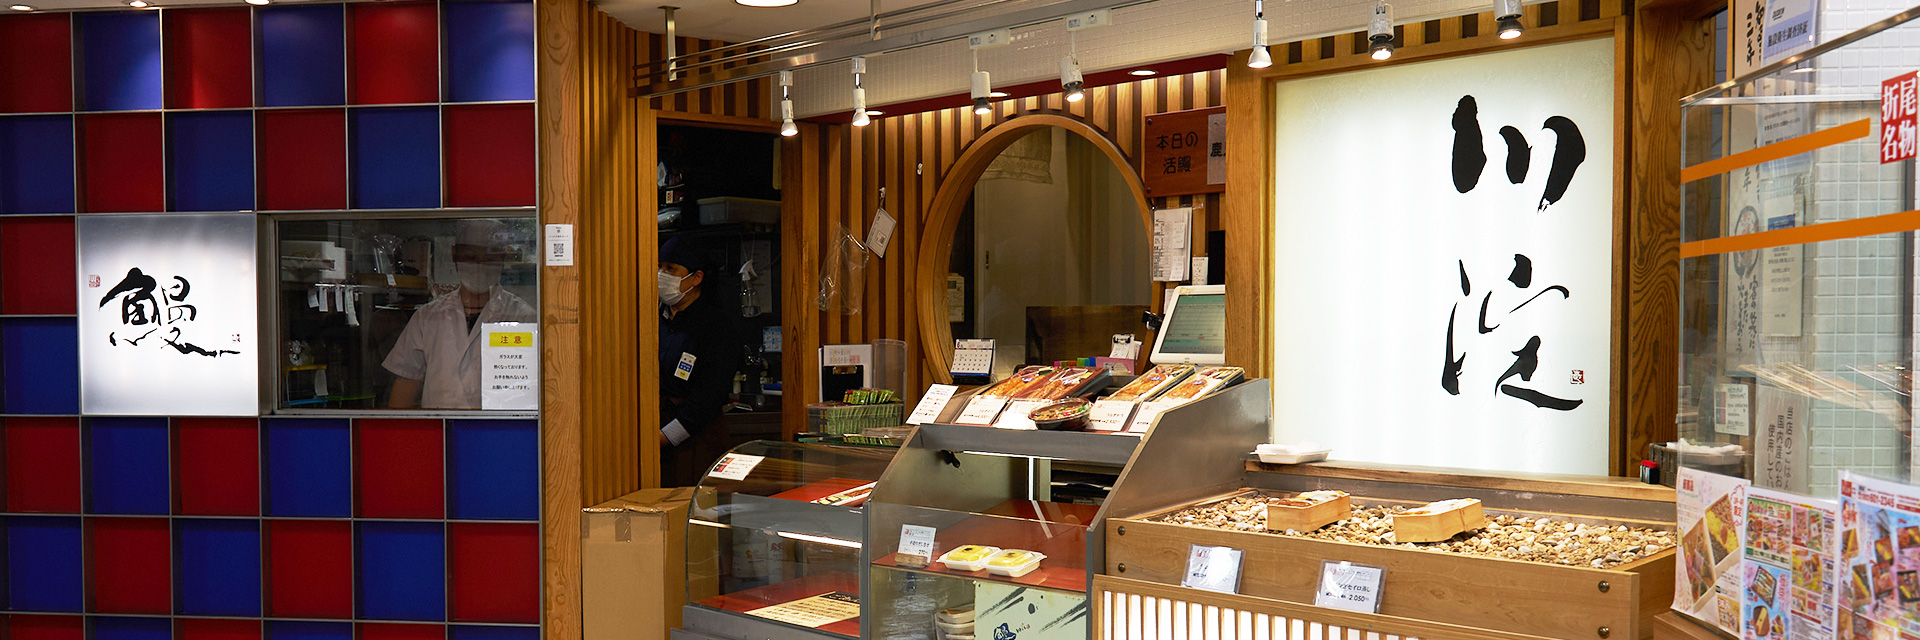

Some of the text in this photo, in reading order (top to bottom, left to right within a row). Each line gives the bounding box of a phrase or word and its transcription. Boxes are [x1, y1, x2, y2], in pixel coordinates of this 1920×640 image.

[1882, 77, 1916, 122] 折尾
[1156, 131, 1199, 150] 本日の
[1882, 119, 1916, 161] 名物
[1163, 156, 1191, 175] 活鰻
[1442, 94, 1586, 411] 川淀
[99, 267, 241, 358] 鰻
[500, 335, 522, 344] 注意
[1766, 423, 1776, 488] 使用してい
